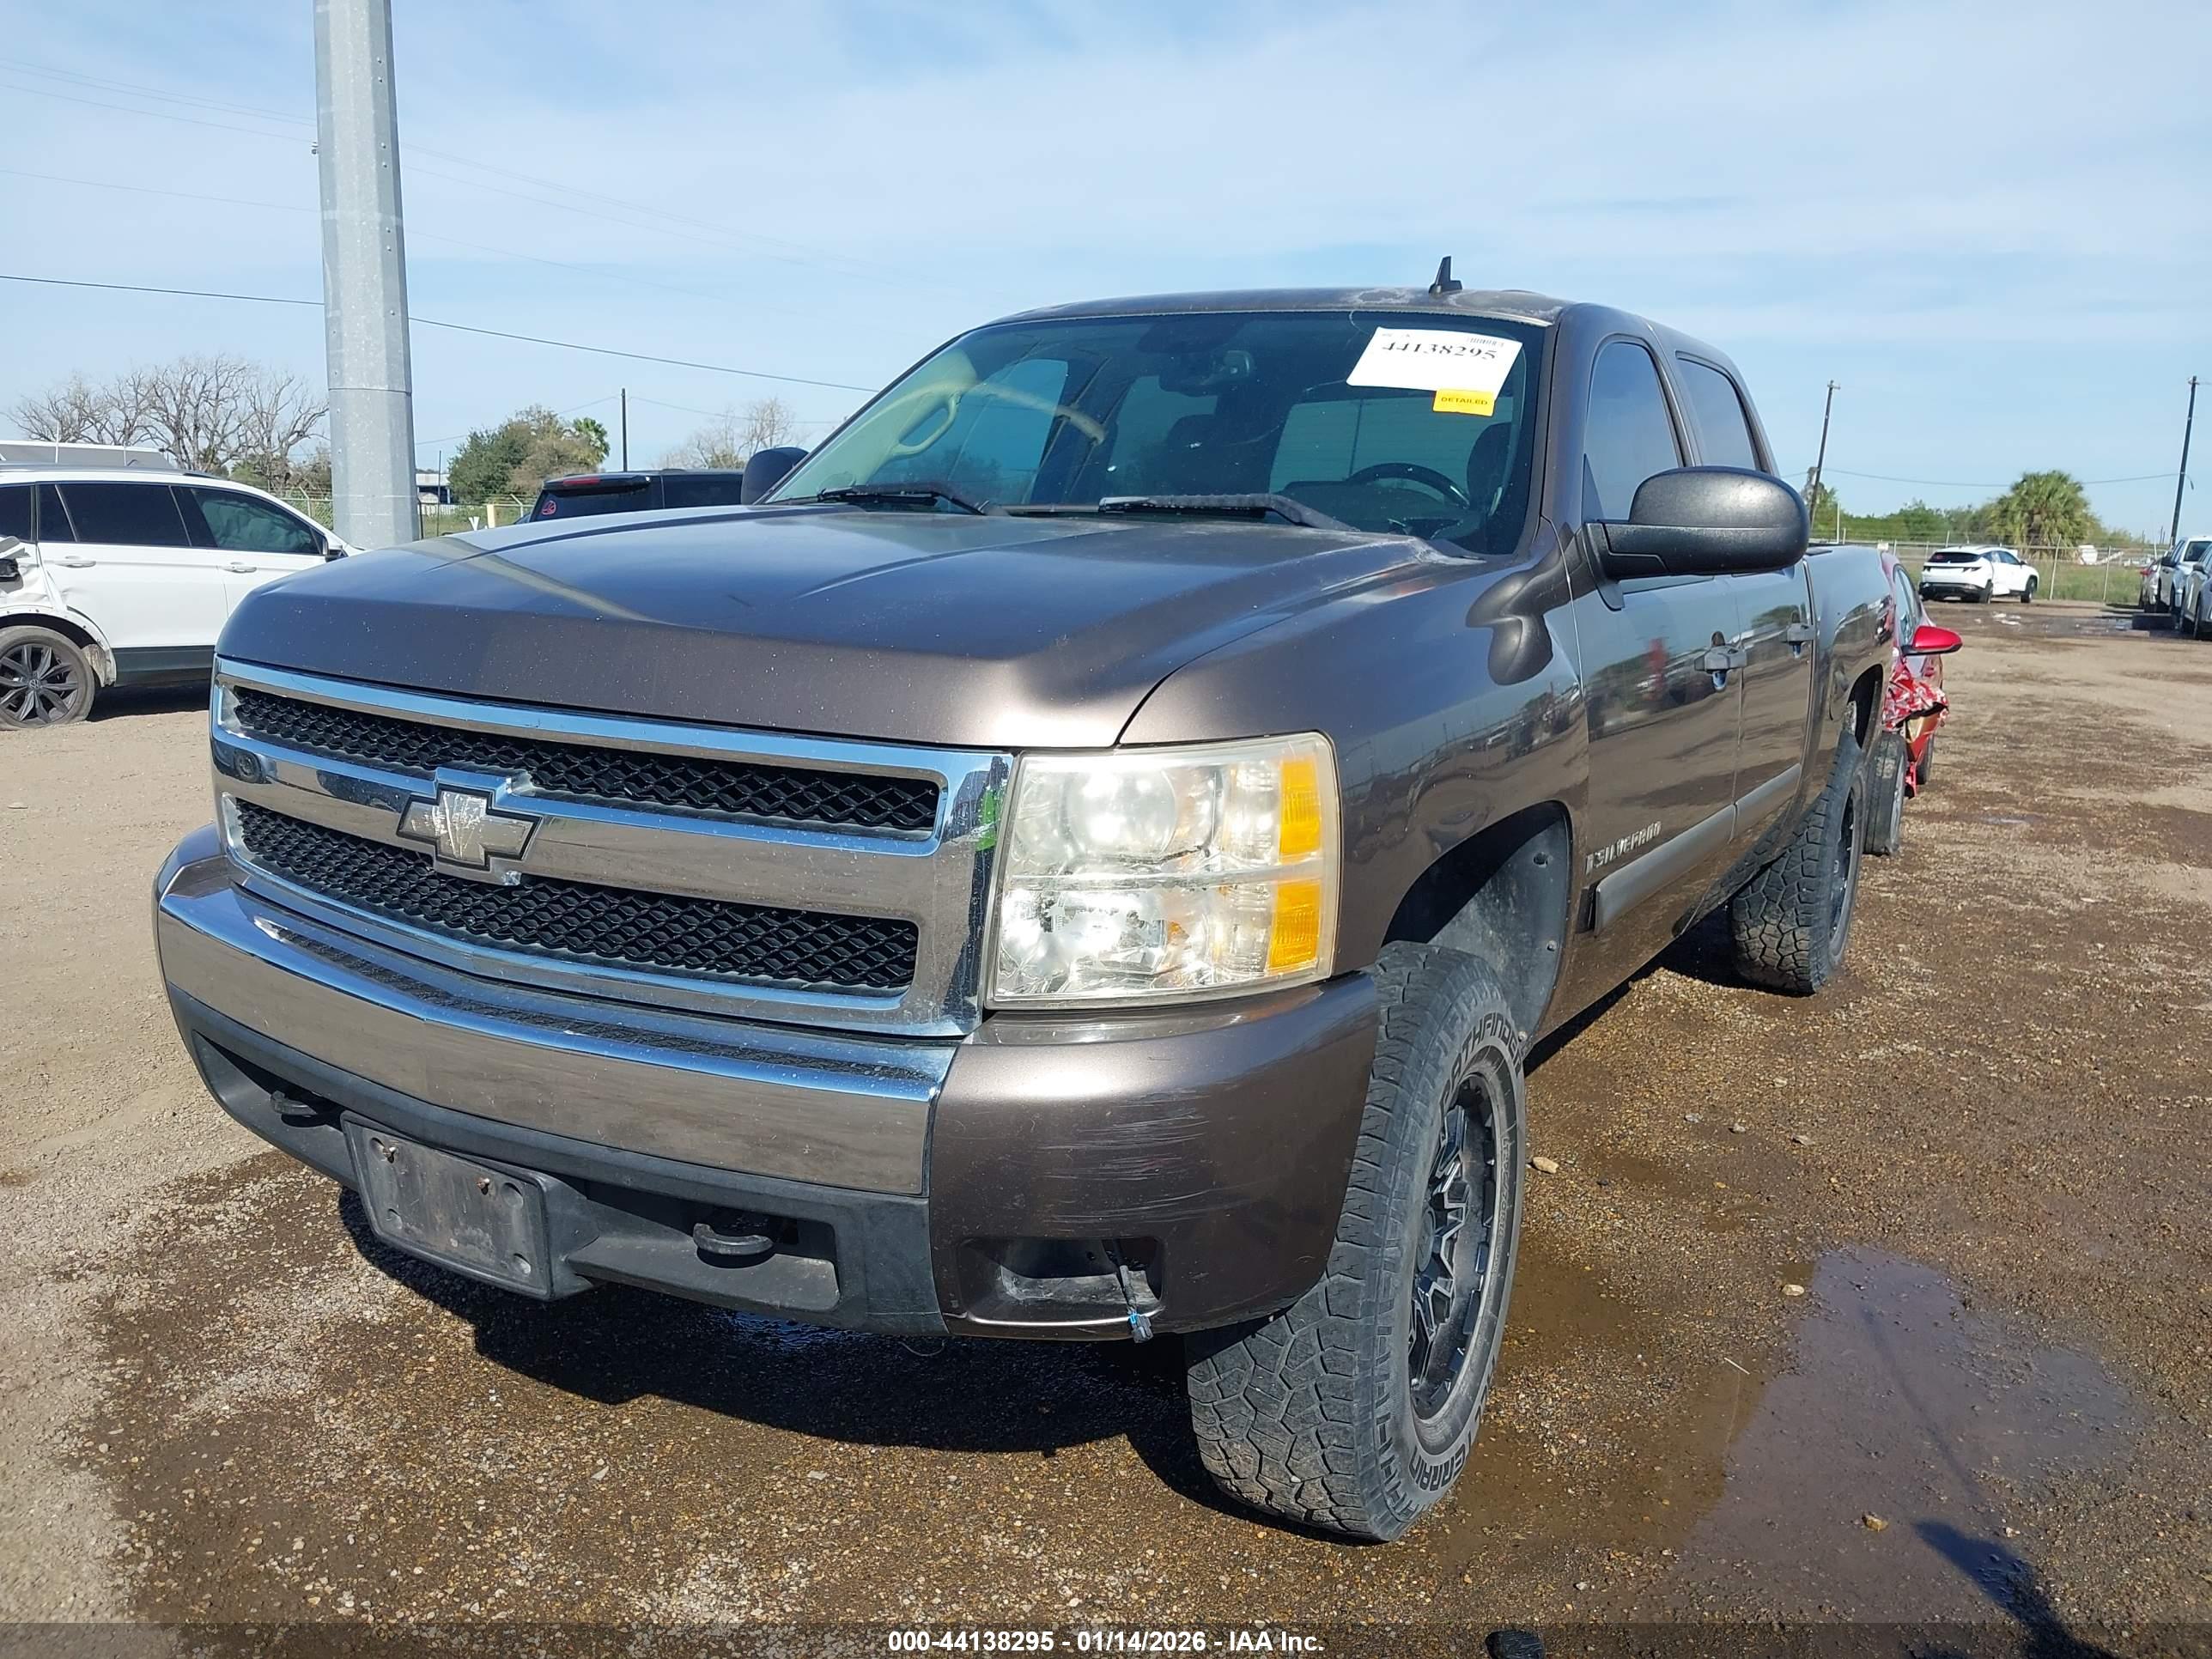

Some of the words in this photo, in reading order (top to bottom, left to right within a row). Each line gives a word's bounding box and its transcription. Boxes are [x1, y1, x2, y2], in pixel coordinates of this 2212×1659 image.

[1382, 342, 1498, 360] 44138295
[1440, 396, 1489, 406] DETAILED
[1439, 1012, 1523, 1118] PATHFINDER
